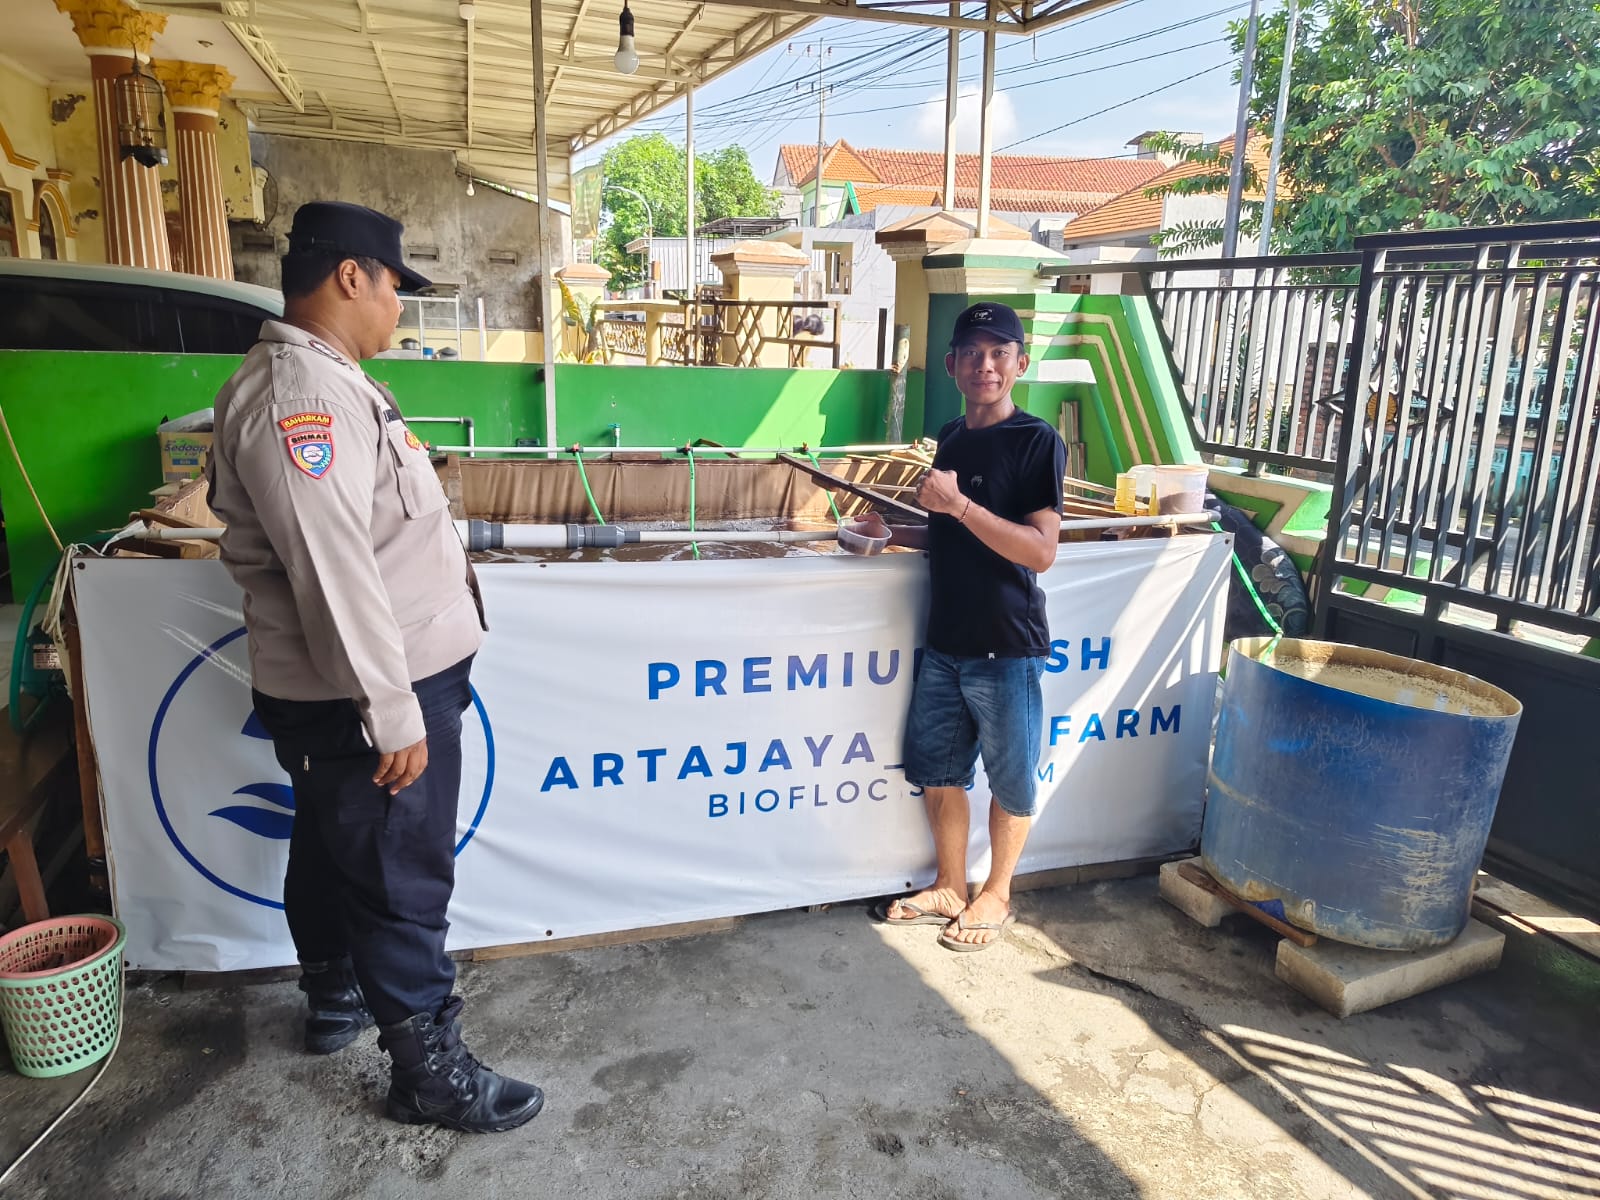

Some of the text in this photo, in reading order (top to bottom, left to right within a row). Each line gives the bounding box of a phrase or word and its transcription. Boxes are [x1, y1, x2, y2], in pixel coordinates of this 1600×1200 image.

[284, 415, 330, 428] BAHARKAM
[647, 636, 1112, 701] PREMIU SH
[708, 778, 889, 818] BIOFLOC
